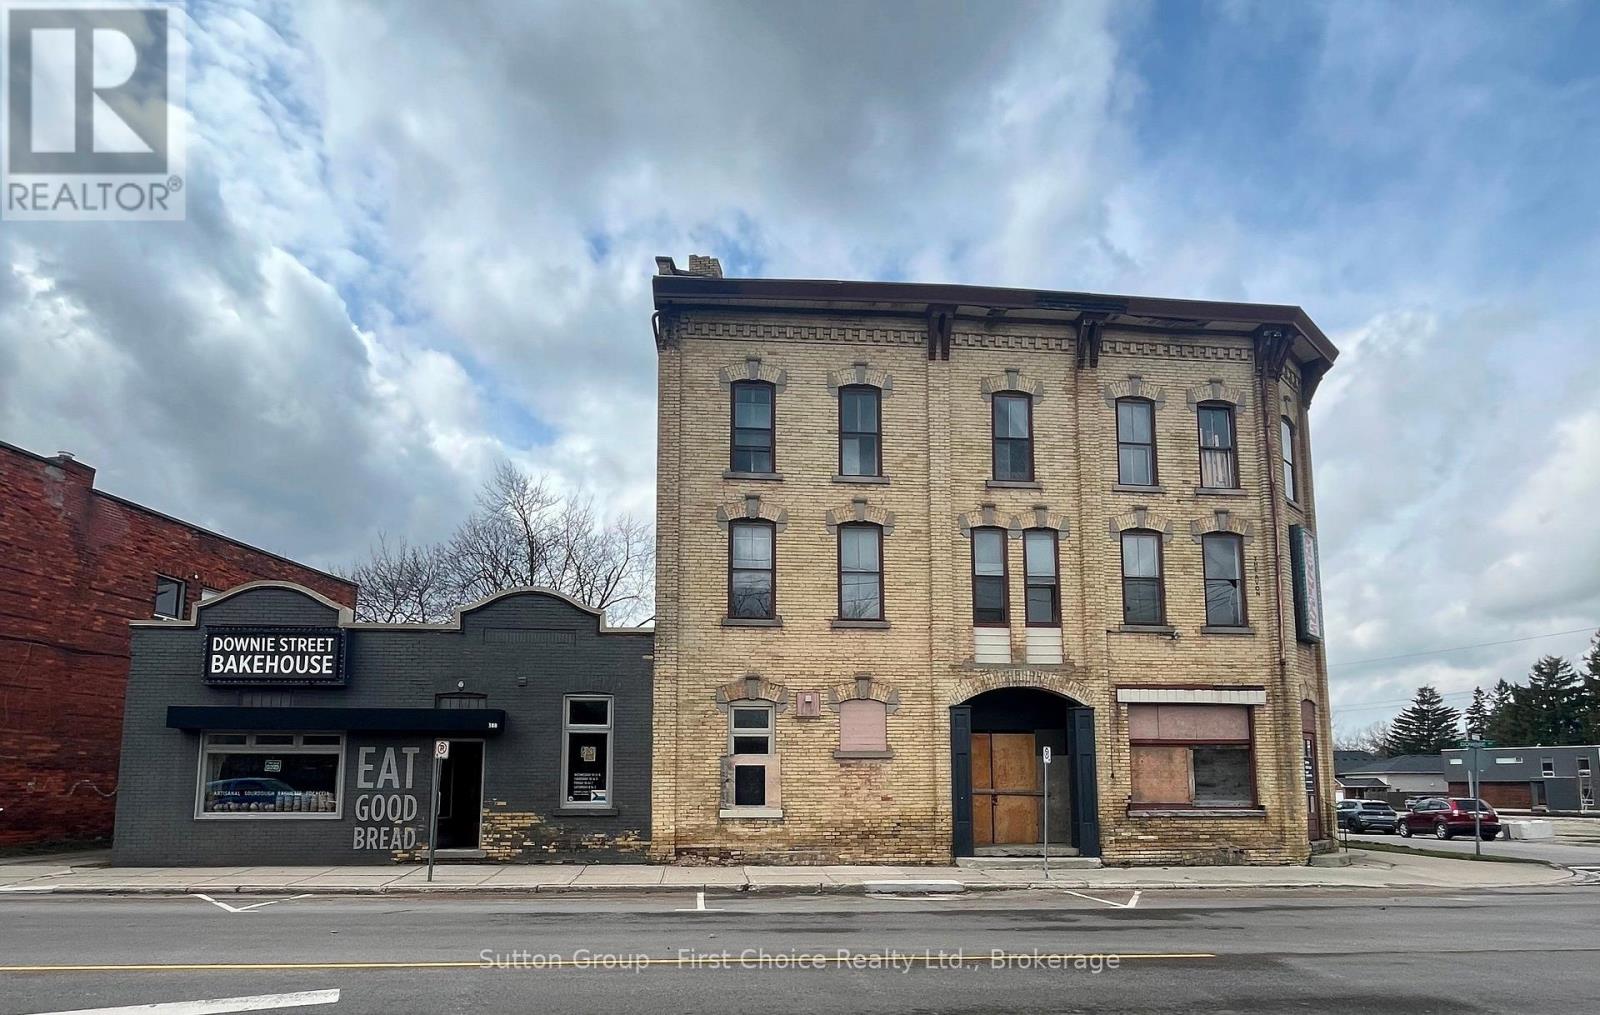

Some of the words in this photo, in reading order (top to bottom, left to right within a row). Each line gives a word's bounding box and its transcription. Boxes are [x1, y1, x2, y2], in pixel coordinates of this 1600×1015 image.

[212, 637, 276, 652] DOWNIE
[279, 637, 334, 652] STREET
[211, 654, 334, 674] BAKEHOUSE
[357, 746, 420, 789] EAT
[355, 794, 418, 822] GOOD
[352, 826, 416, 850] BREAD
